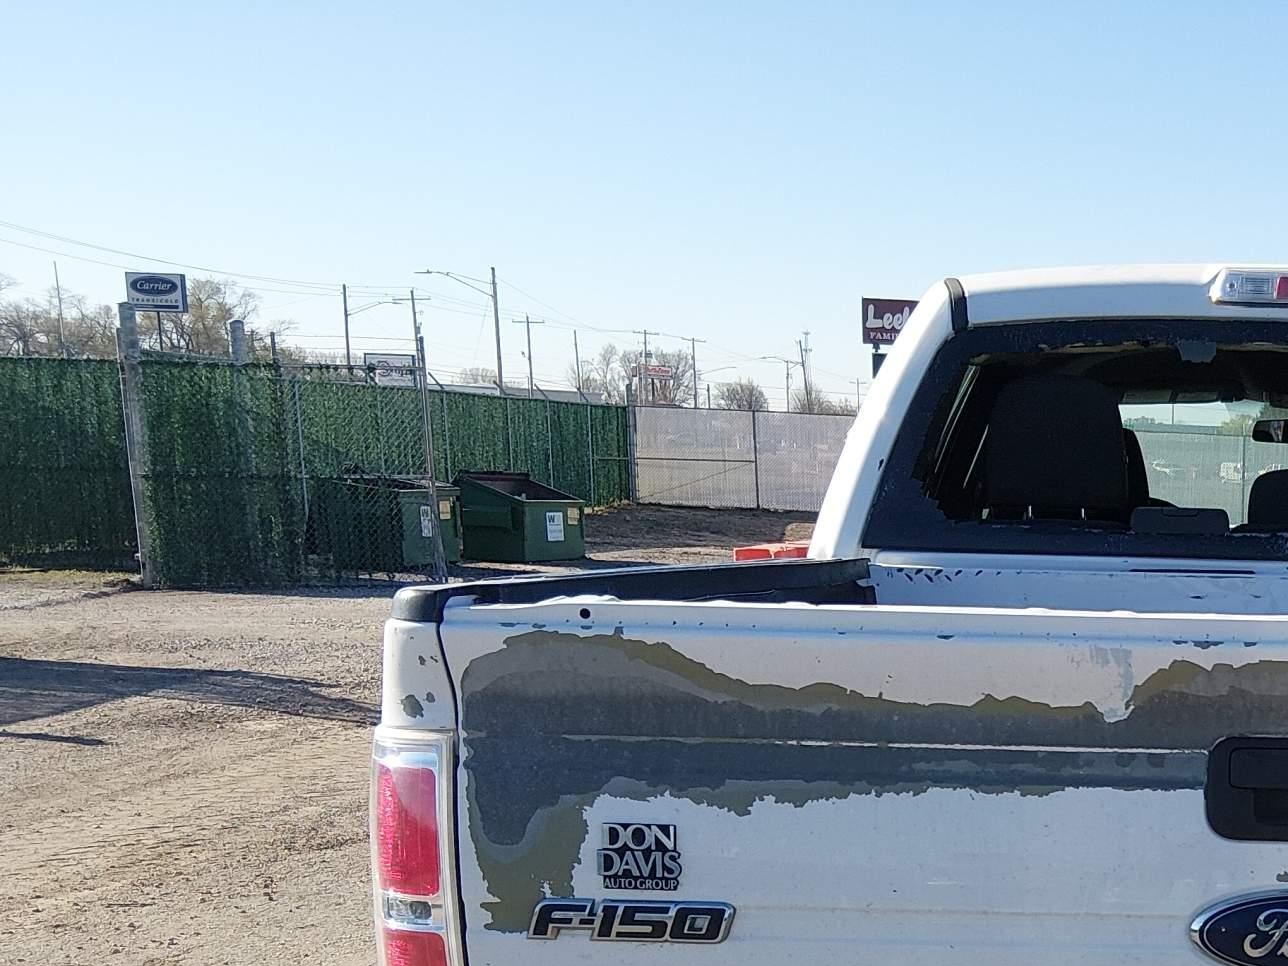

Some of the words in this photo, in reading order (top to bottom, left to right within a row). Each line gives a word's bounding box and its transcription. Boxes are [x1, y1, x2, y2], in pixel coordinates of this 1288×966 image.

[136, 280, 172, 290] Carrier
[869, 332, 900, 341] FAMI
[602, 823, 675, 850] DON
[599, 851, 681, 878] DAVIS
[604, 878, 635, 888] AUTO
[636, 879, 678, 890] GROUP
[528, 898, 736, 943] F-150
